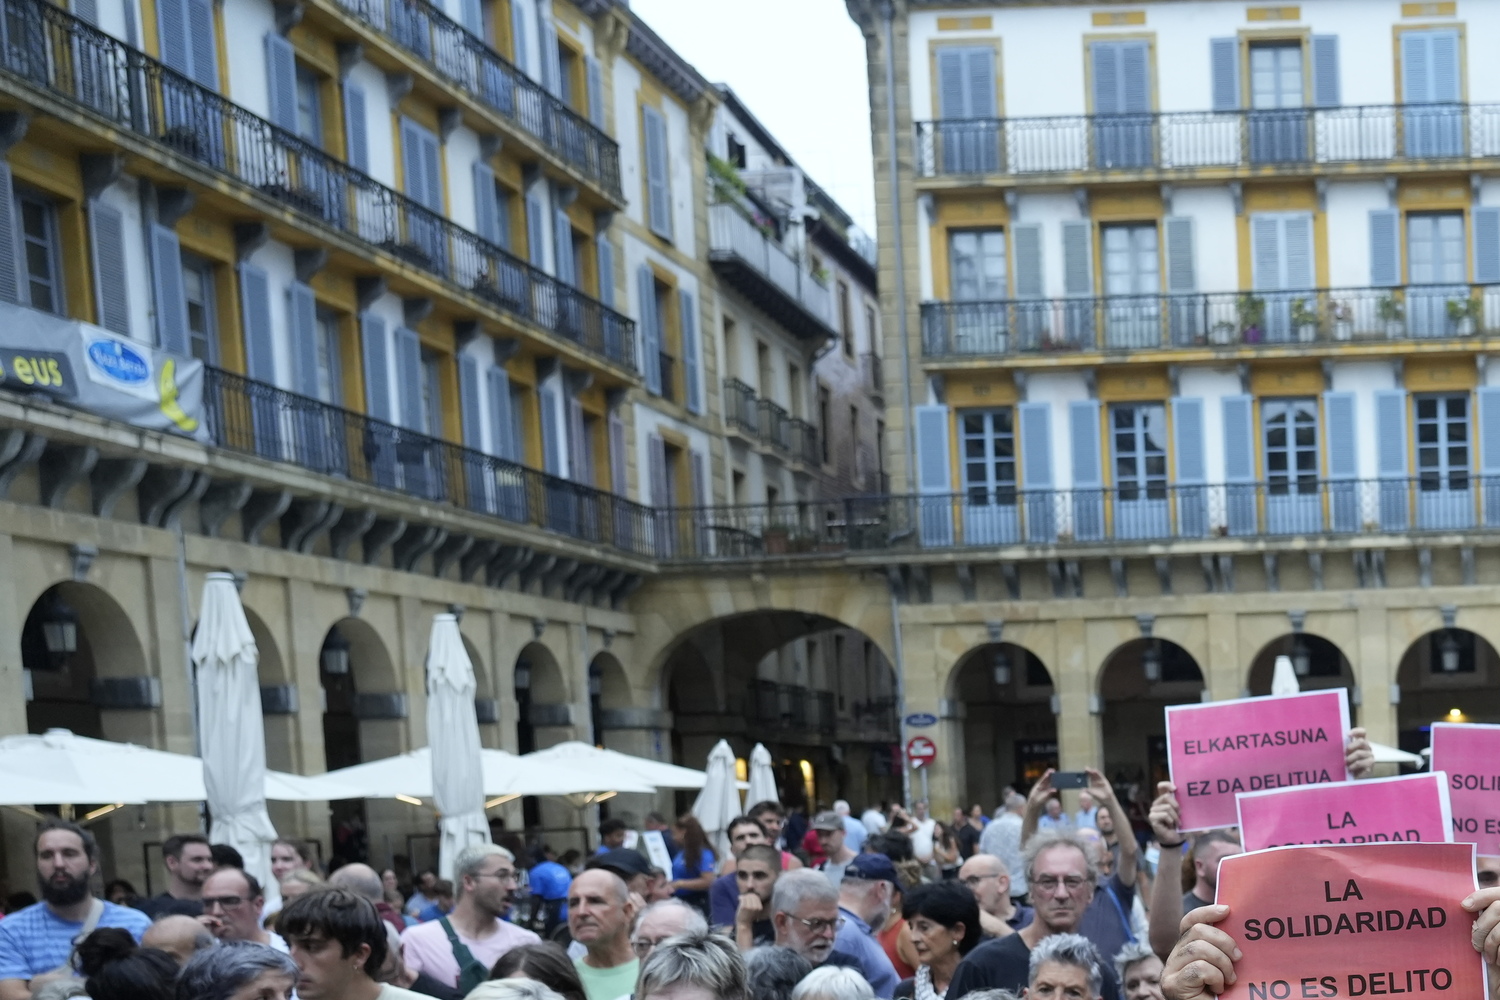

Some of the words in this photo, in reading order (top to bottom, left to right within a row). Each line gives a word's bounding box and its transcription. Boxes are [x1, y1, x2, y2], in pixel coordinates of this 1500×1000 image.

[1184, 727, 1328, 755] ELKARTASUNA
[1187, 781, 1211, 797] EZ
[1217, 778, 1245, 794] DA
[1250, 768, 1332, 791] DELITUA
[1327, 811, 1356, 829] LA
[1452, 817, 1478, 833] NO
[1324, 879, 1363, 902] LA
[1244, 906, 1446, 940] SOLIDARIDAD
[1249, 980, 1291, 1000] NO
[1301, 976, 1338, 998] ES
[1348, 968, 1453, 997] DELITO
